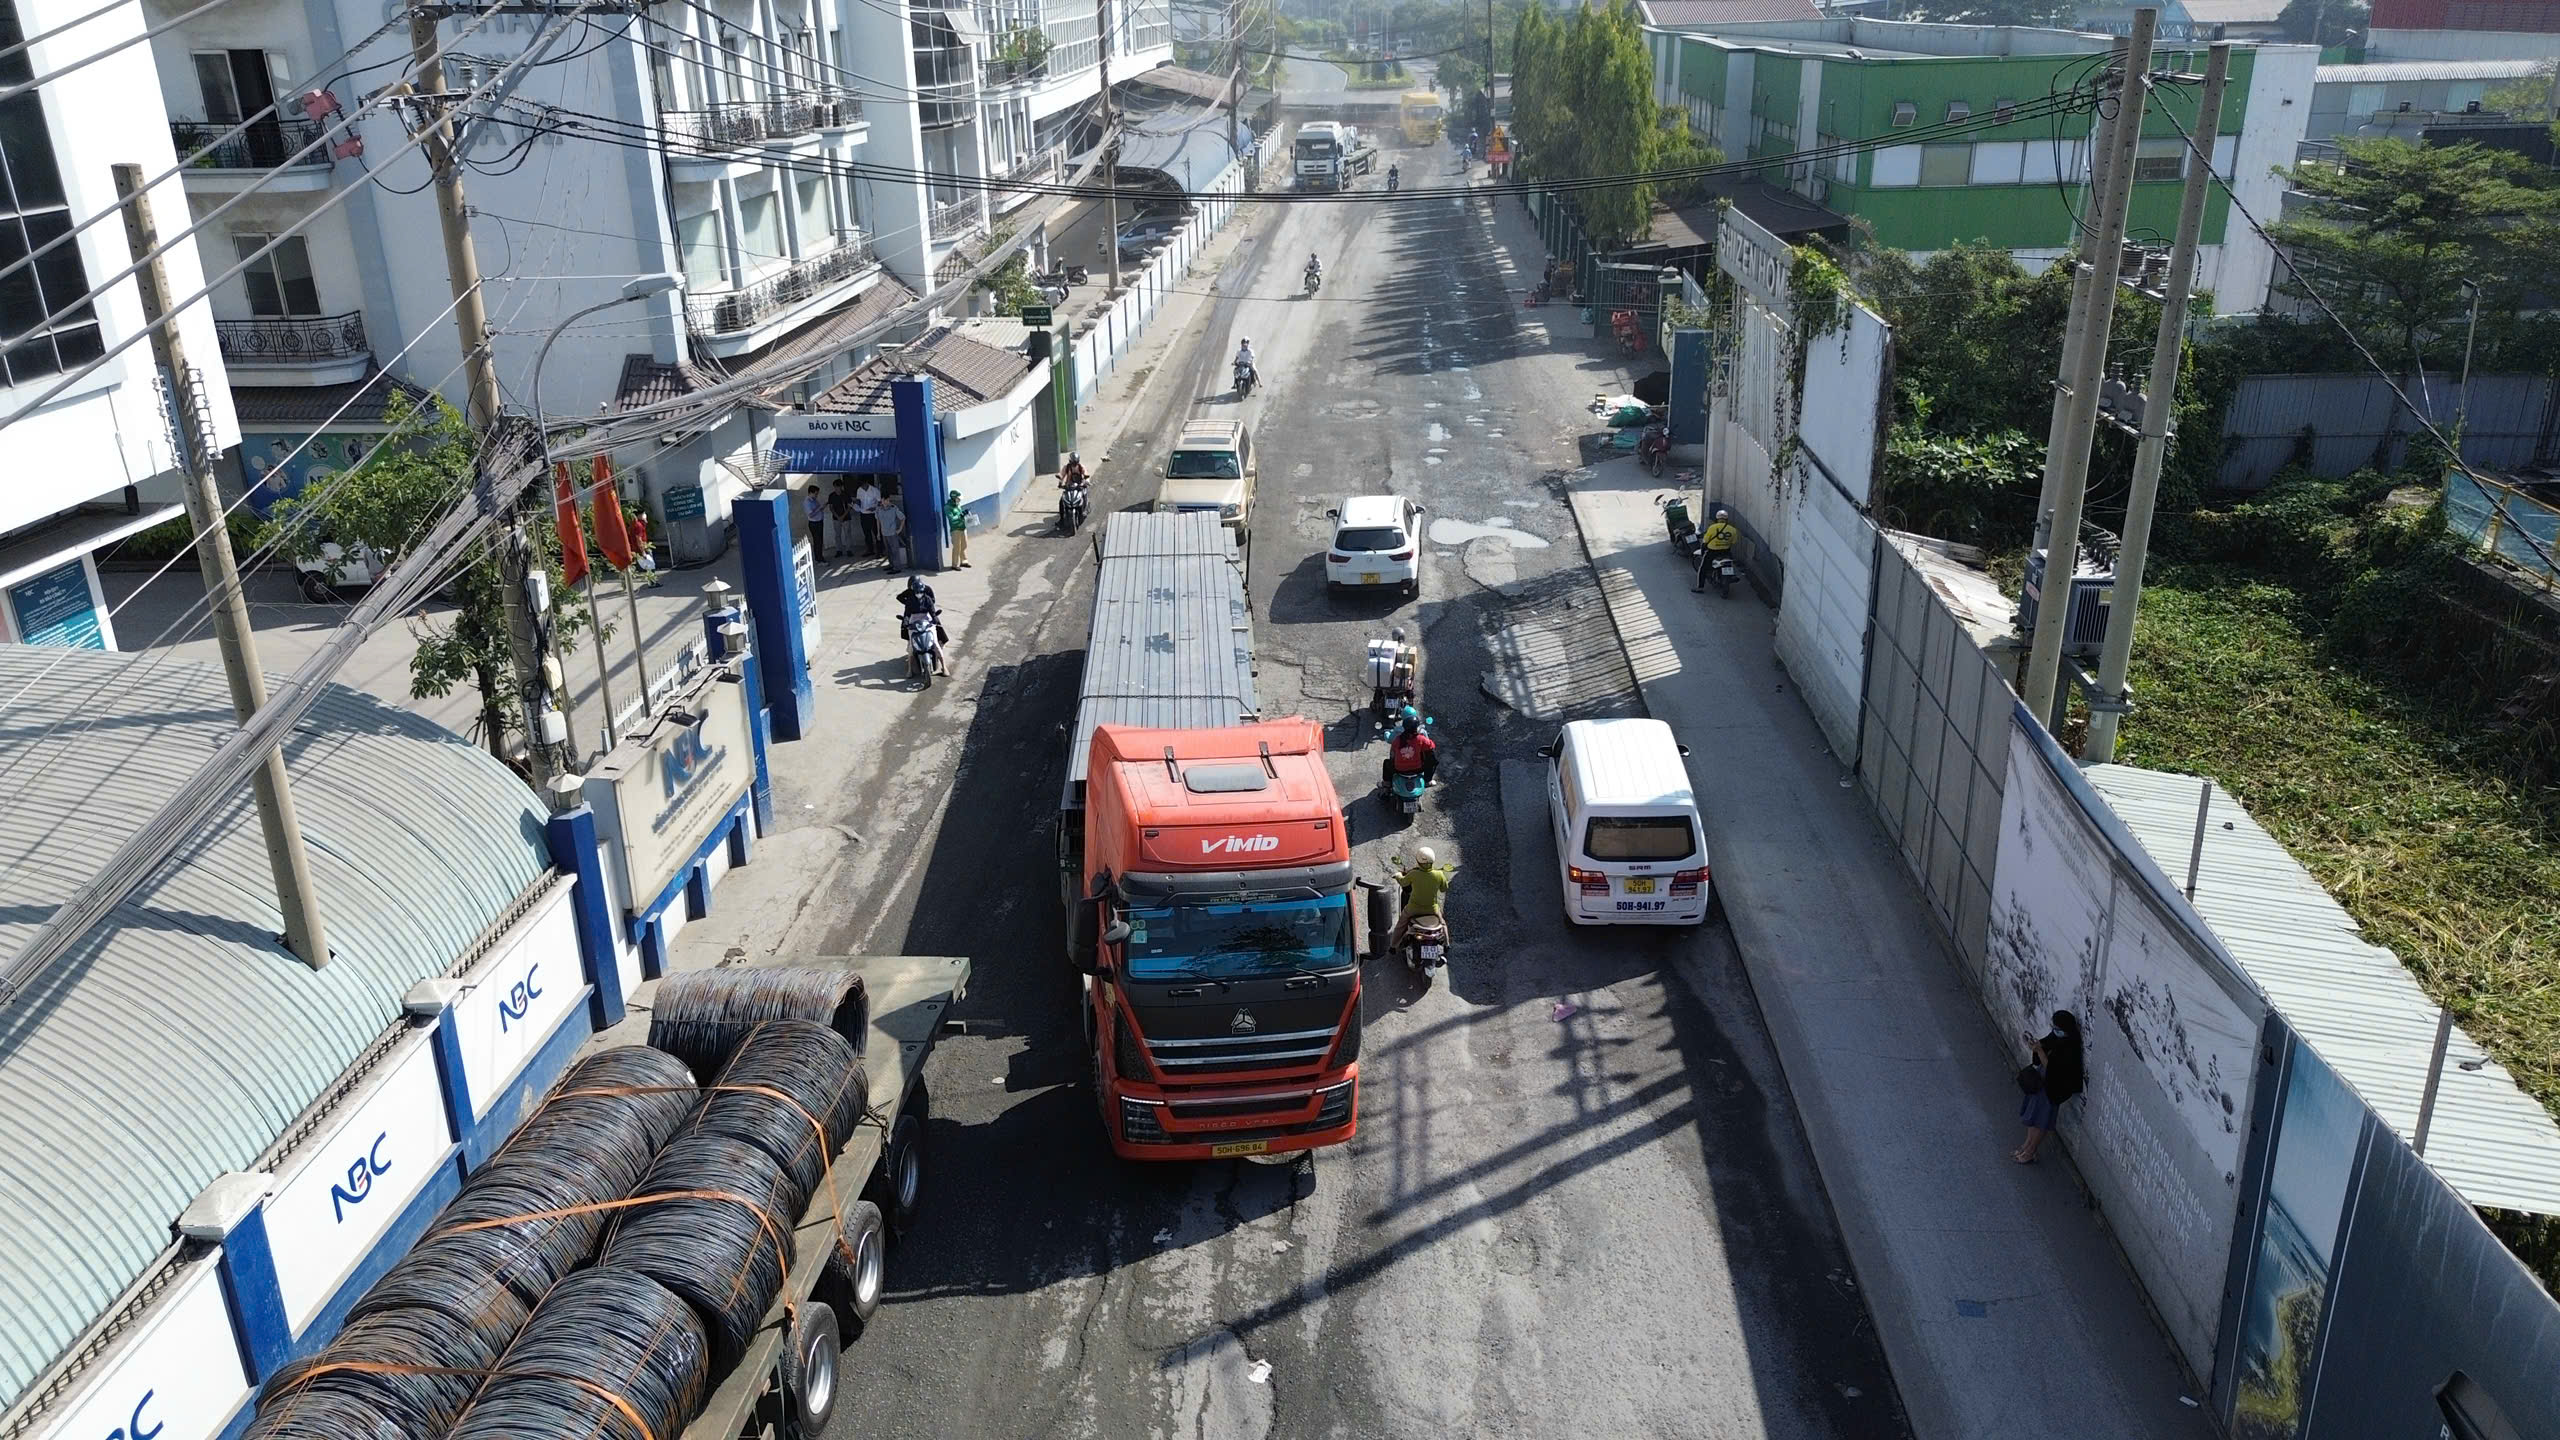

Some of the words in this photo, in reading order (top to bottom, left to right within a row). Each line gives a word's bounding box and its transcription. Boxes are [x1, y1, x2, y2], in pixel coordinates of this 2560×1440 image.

[1721, 222, 1758, 281] SHIZEN
[1759, 250, 1786, 302] HOM
[808, 420, 828, 431] BẢO
[845, 420, 871, 432] NBC
[1616, 901, 1666, 911] 50H-941.97
[499, 962, 543, 1034] NBC
[2121, 1109, 2148, 1157] NGANG
[331, 1131, 392, 1224] NBC
[2152, 1135, 2186, 1193] KHOÁNG
